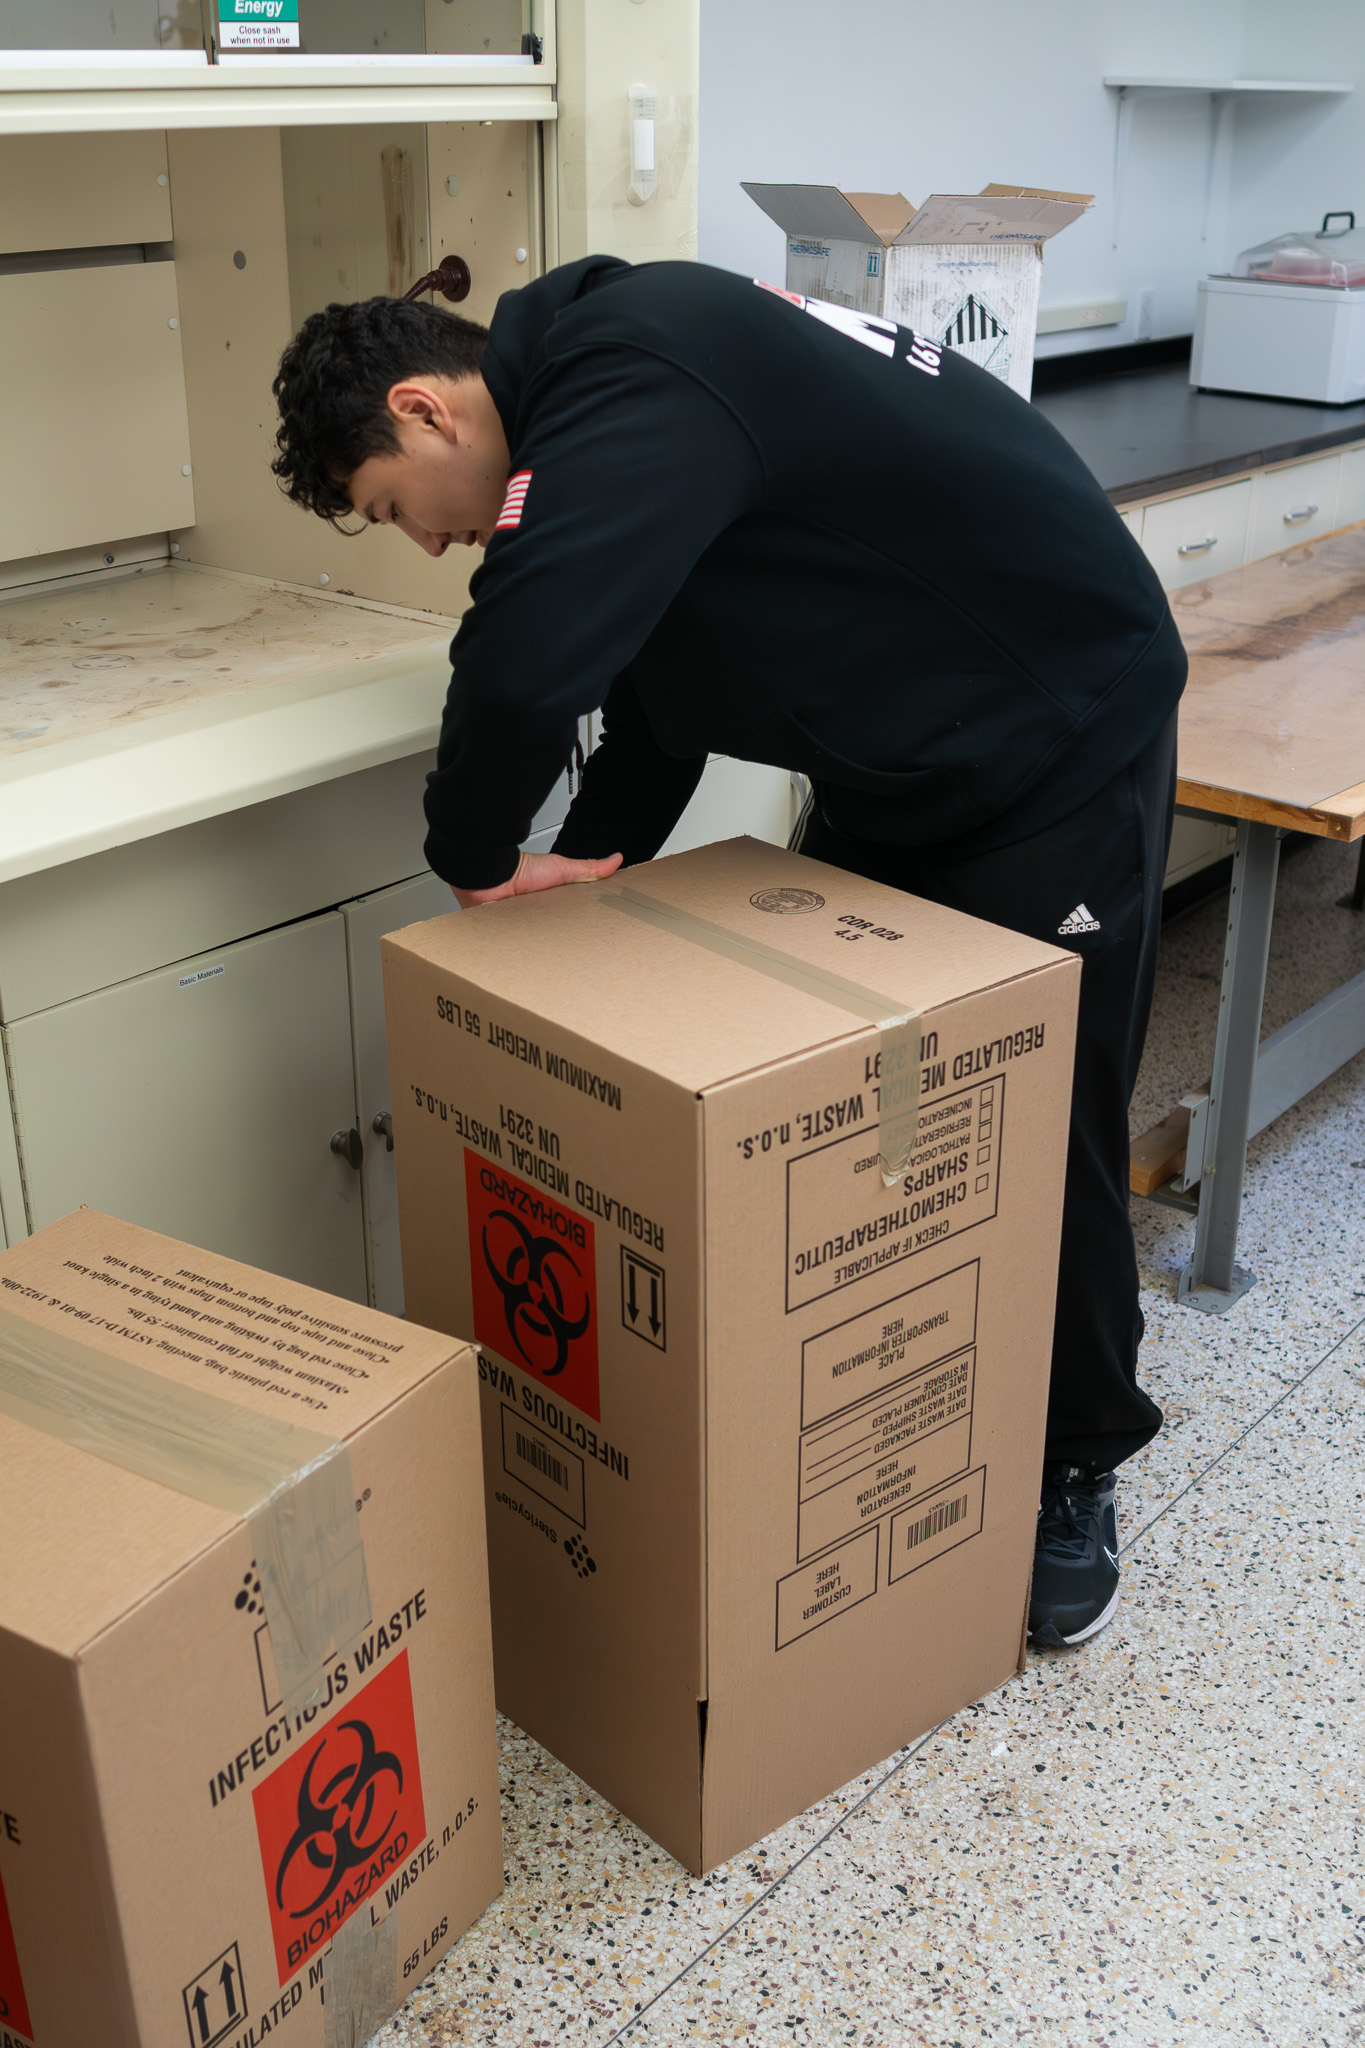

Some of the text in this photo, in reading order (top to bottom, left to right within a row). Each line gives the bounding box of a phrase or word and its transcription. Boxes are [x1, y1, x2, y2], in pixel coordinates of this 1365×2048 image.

[234, 0, 283, 18] Energy
[239, 26, 280, 34] Close sash
[230, 36, 251, 45] when
[253, 36, 265, 44] not
[267, 36, 275, 44] in
[834, 929, 864, 942] 4.5
[837, 915, 905, 942] COR 028
[1057, 920, 1101, 935] adidas
[179, 966, 224, 987] Basic Materials
[436, 995, 621, 1110] MAXIMUM WEIGHT 55 LBS
[952, 1023, 1044, 1080] REGULATED
[796, 1094, 863, 1141] WASTE,
[499, 1104, 560, 1160] UN 3291
[736, 1122, 790, 1159] n.o.s.
[909, 1133, 970, 1167] PATHOLOGICA
[410, 1084, 664, 1251] REGULATED MEDICAL WASTE, n.o.s.
[903, 1151, 968, 1196] SHARPS
[480, 1168, 585, 1248] BIOHAZARD
[795, 1181, 966, 1274] CHEMOTHERAPEUTIC
[834, 1219, 949, 1283] CHECK IF APPLICABLE
[62, 1260, 90, 1275] knot
[102, 1255, 128, 1268] wide
[129, 1264, 154, 1279] inch
[88, 1271, 121, 1286] single
[150, 1274, 163, 1282] 2
[162, 1277, 186, 1290] with
[128, 1286, 143, 1296] in
[141, 1290, 171, 1306] tying
[187, 1287, 215, 1302] flaps
[47, 1297, 61, 1306] &
[58, 1303, 91, 1319] 09-01
[168, 1302, 200, 1318] hand
[175, 1269, 404, 1352] pressure sensitive poly tape or equivalent
[215, 1297, 256, 1317] bottom
[87, 1316, 119, 1331] D-17
[127, 1307, 146, 1320] lbs.
[143, 1315, 161, 1325] 55
[197, 1313, 224, 1325] and
[254, 1312, 280, 1324] and
[116, 1327, 152, 1344] ASTM
[161, 1321, 218, 1345] container:
[223, 1321, 269, 1343] twisting
[279, 1320, 300, 1332] top
[300, 1329, 328, 1342] tape
[881, 1317, 903, 1339] HERE
[156, 1340, 202, 1362] meeting
[215, 1343, 240, 1355] full
[271, 1339, 286, 1350] by
[285, 1344, 309, 1359] bag
[325, 1338, 352, 1349] and
[831, 1310, 948, 1377] TRANSPORTER INFORMATION
[235, 1351, 254, 1359] of
[252, 1356, 293, 1374] weight
[307, 1354, 332, 1365] red
[878, 1346, 905, 1369] PLACE
[228, 1369, 270, 1387] plastic
[923, 1360, 968, 1392] IN STORAGE
[265, 1384, 290, 1395] red
[871, 1371, 968, 1428] DATE CONTAINER PLACED
[477, 1354, 628, 1479] INFECTIOUS WAS
[882, 1384, 967, 1436] DATE WASTE SHIPPED
[873, 1397, 966, 1453] DATE WASTE PACKAGED
[875, 1459, 898, 1480] HERE
[856, 1465, 916, 1505] INFORMATION
[860, 1482, 911, 1517] GENERATOR
[815, 1561, 839, 1583] HERE
[813, 1575, 841, 1598] LABEL
[802, 1584, 851, 1620] CUSTOMER
[354, 1589, 426, 1672] WASTE
[385, 1839, 439, 1908] WASTE,
[442, 1797, 478, 1846] n.o.s.
[287, 1832, 407, 1966] BIOHAZARD
[402, 1916, 448, 1978] 55 LBS
